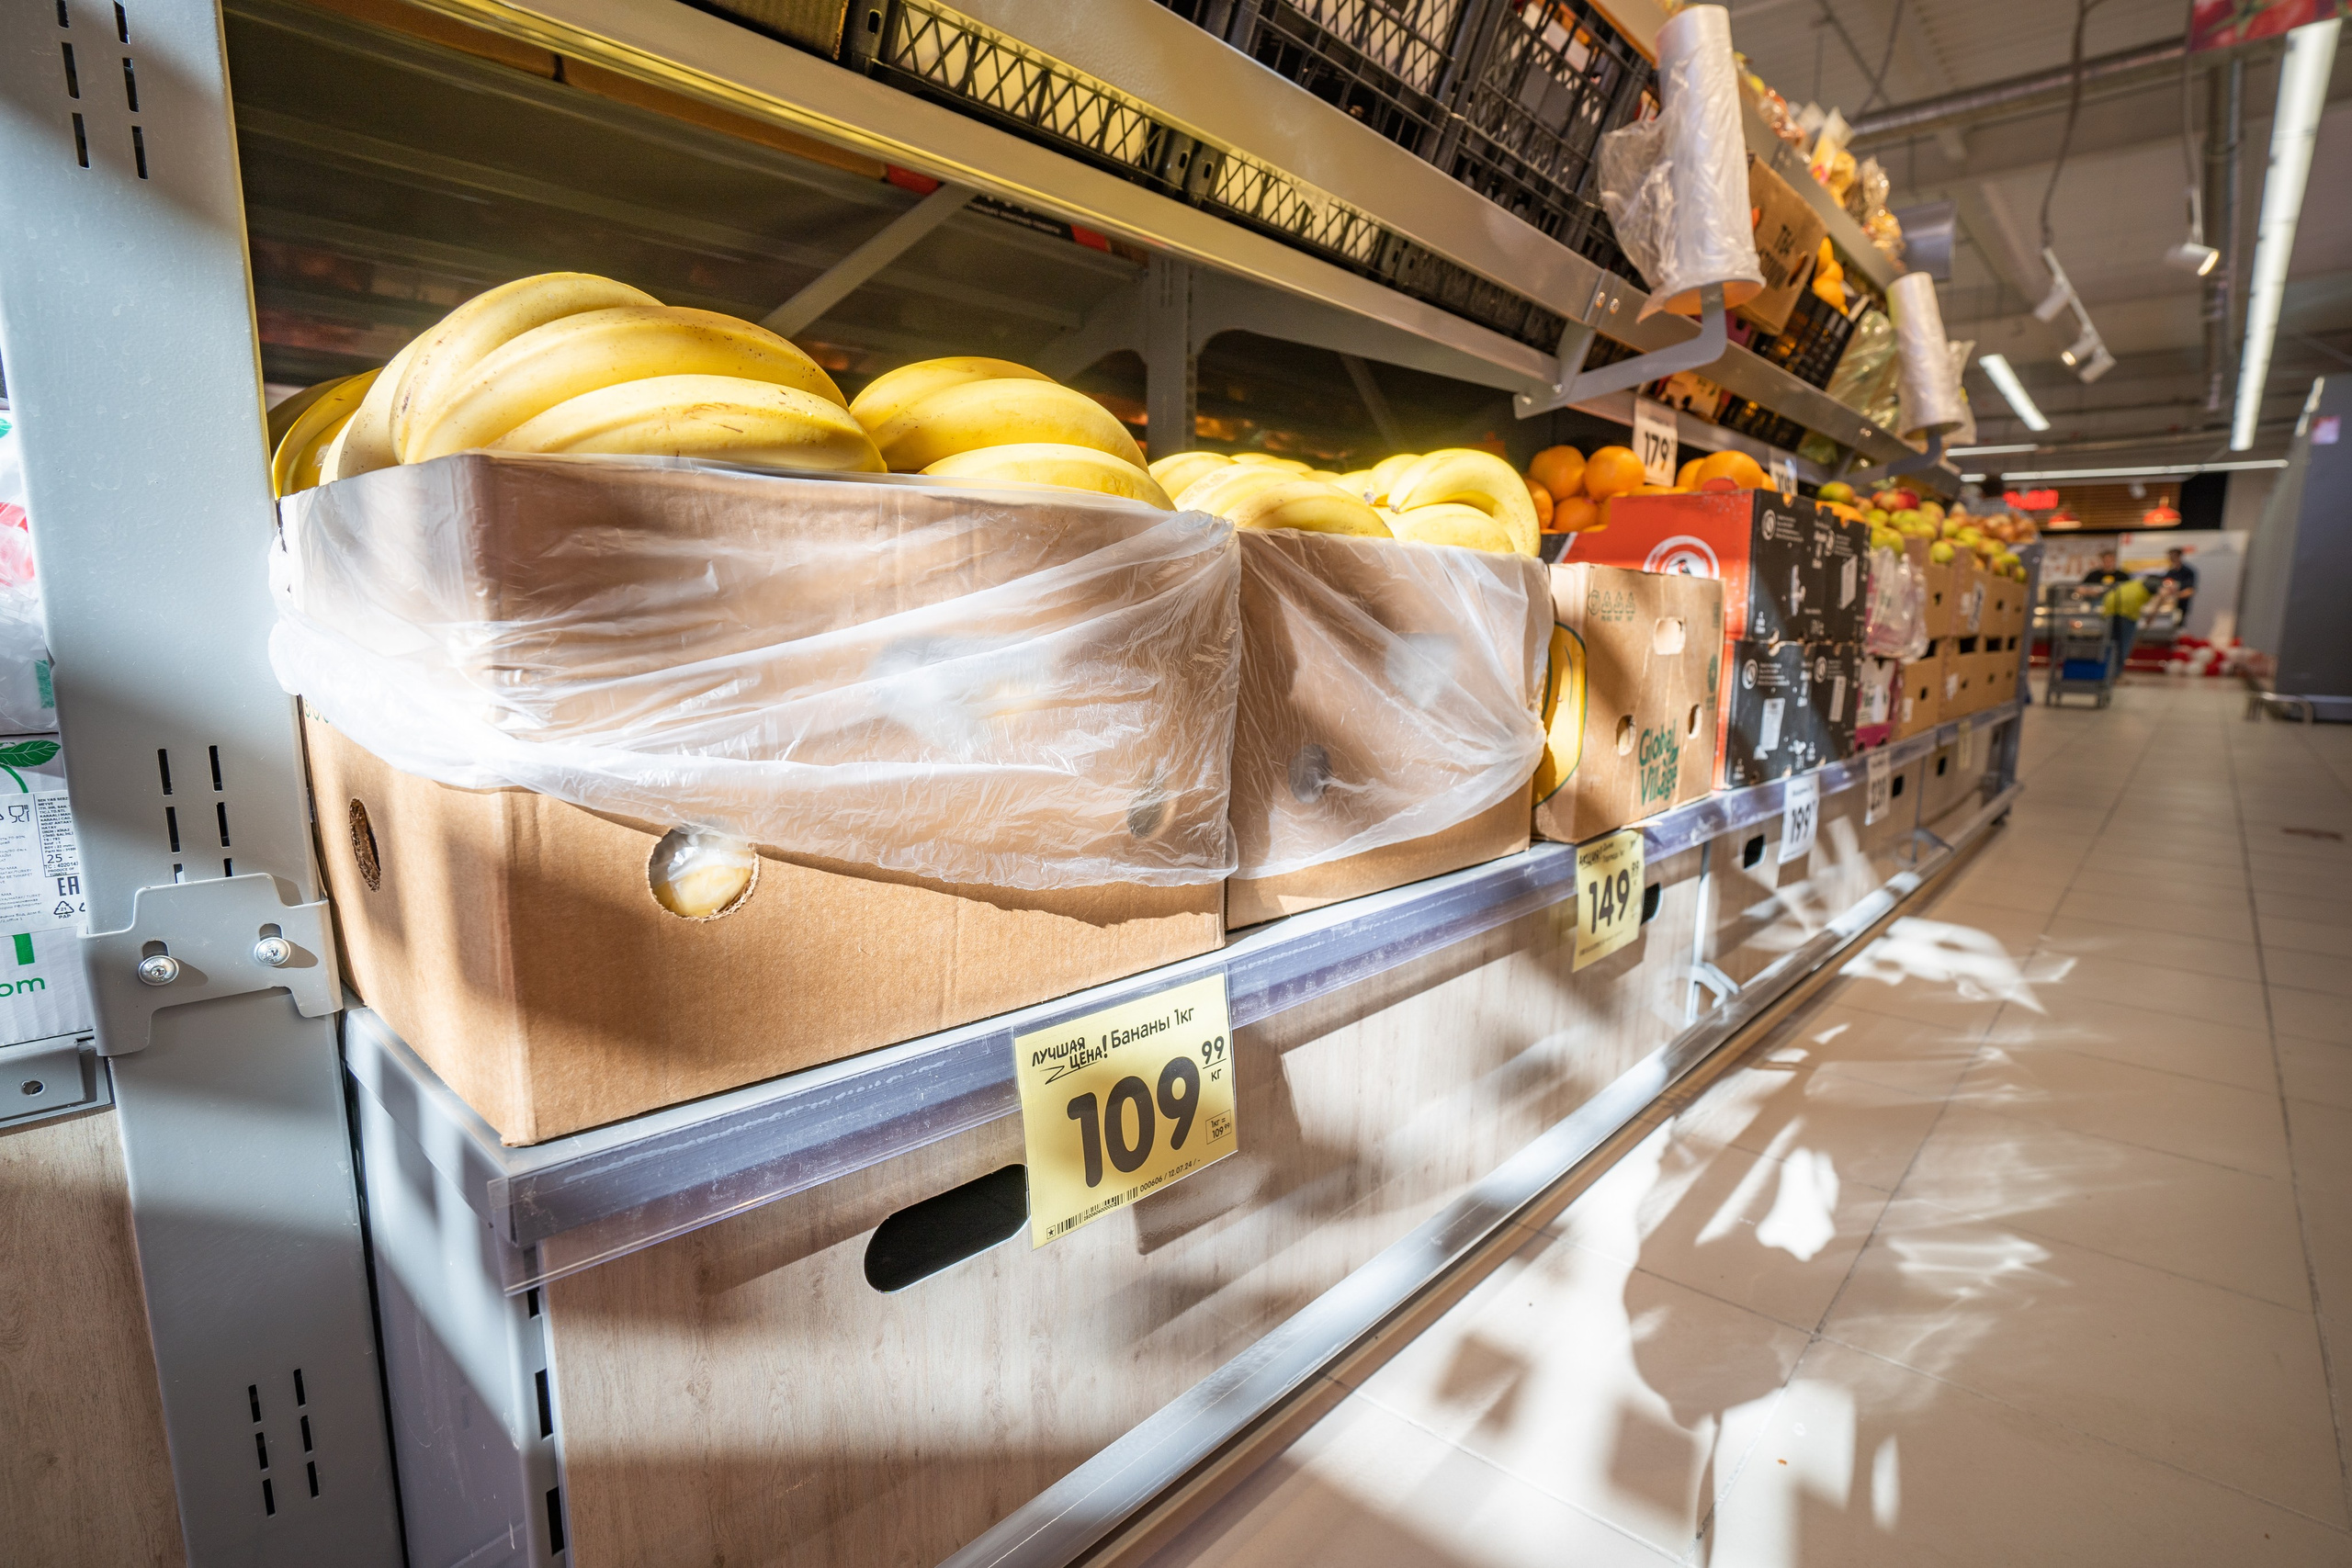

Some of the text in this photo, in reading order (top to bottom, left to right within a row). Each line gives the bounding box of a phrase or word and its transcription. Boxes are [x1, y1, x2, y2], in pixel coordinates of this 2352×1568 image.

[1645, 432, 1669, 471] 179
[1639, 718, 1677, 767] Global
[1640, 763, 1679, 807] Village
[1791, 803, 1812, 844] 199
[47, 853, 63, 864] 25
[1589, 868, 1630, 935] 149
[1111, 1007, 1194, 1049] Бананы 1кг
[1032, 1037, 1086, 1066] ЛУЧШАЯ
[1069, 1034, 1108, 1070] ЦЕНА!
[1202, 1035, 1225, 1065] 99
[1211, 1068, 1222, 1082] кг
[1067, 1056, 1201, 1188] 109
[1212, 1126, 1224, 1138] 109
[1140, 1175, 1163, 1192] 000606
[1168, 1159, 1193, 1179] 12.07.24
